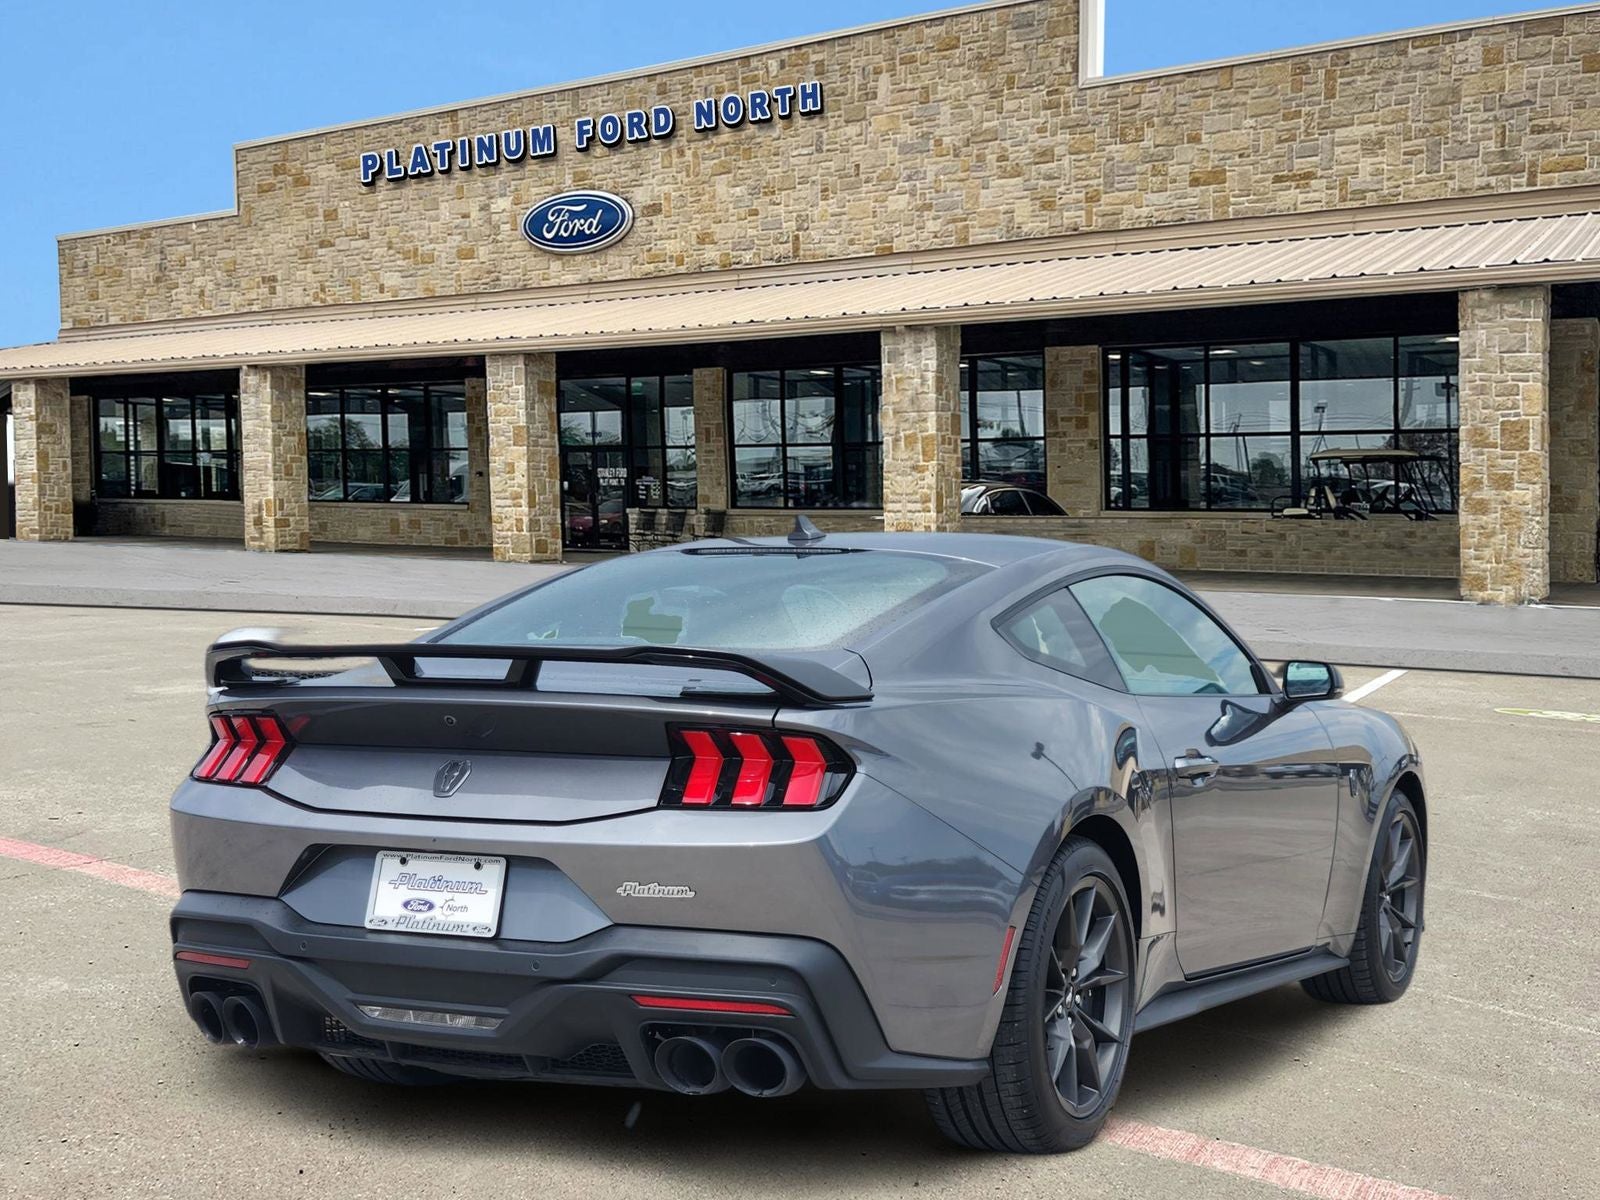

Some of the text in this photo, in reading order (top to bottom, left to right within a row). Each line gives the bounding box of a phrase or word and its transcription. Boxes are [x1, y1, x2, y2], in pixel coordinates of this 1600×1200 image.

[360, 81, 824, 186] PLATINUM FORD NORTH
[541, 203, 602, 239] Ford
[388, 872, 488, 895] Platinum
[616, 881, 696, 898] Platinum
[406, 899, 430, 912] Ford
[446, 904, 469, 913] North
